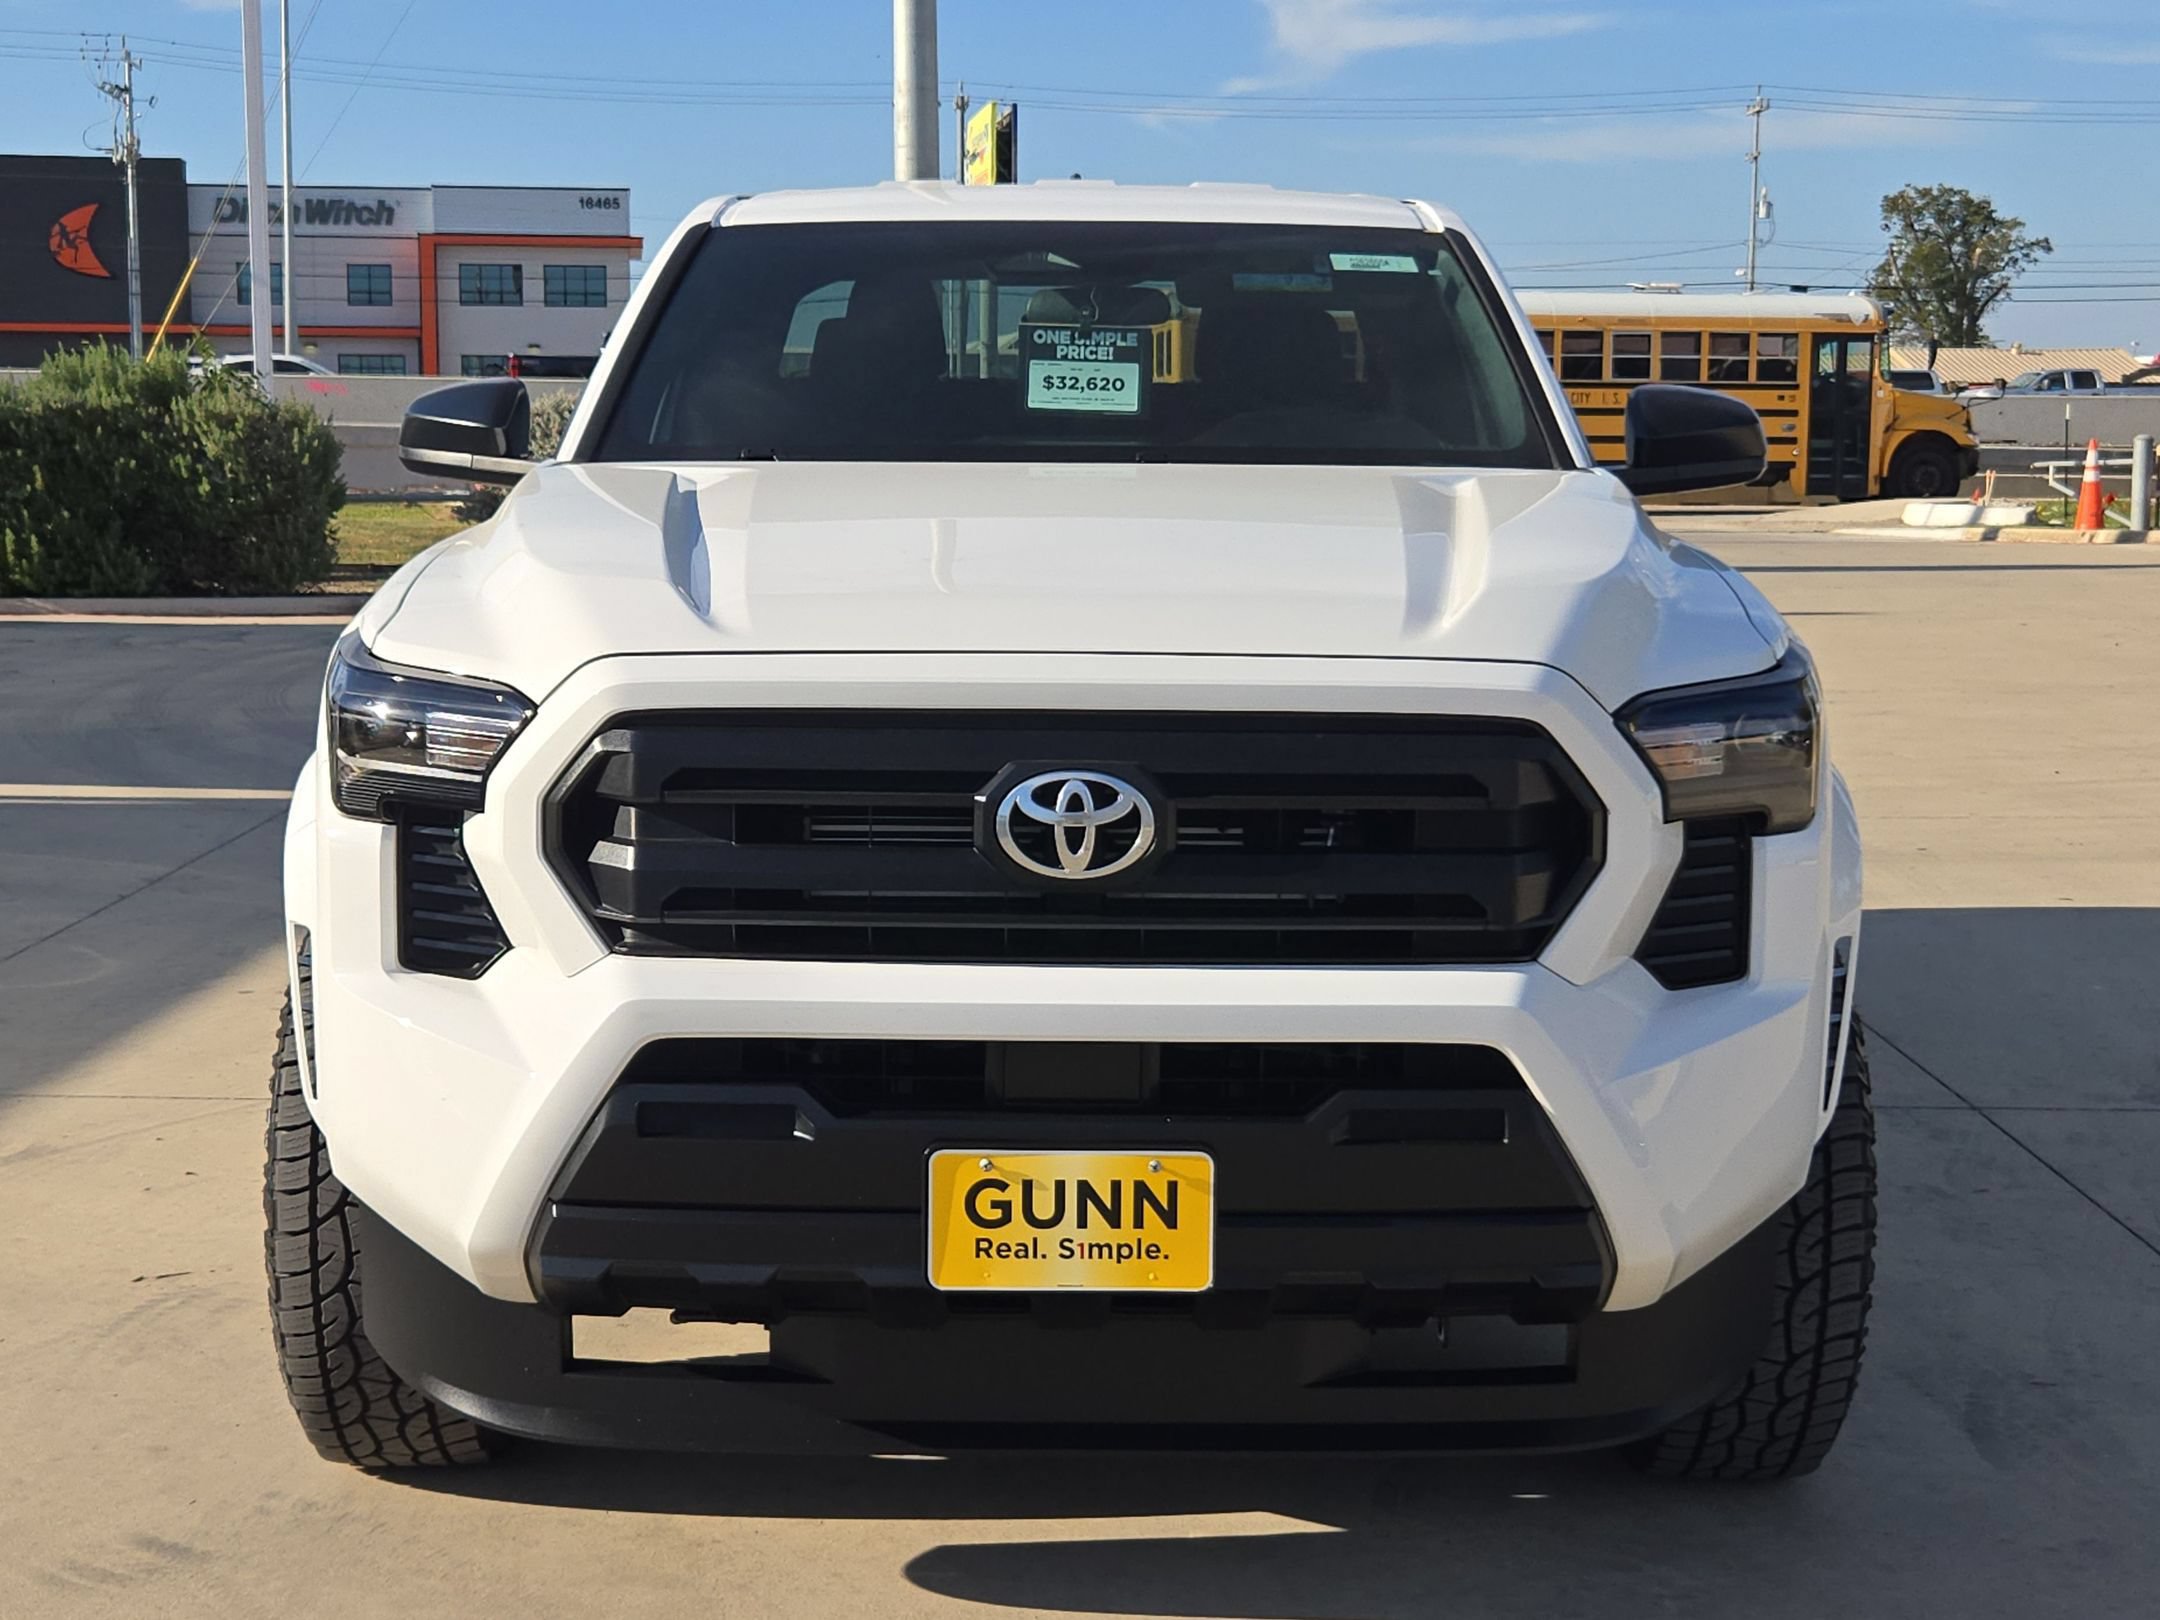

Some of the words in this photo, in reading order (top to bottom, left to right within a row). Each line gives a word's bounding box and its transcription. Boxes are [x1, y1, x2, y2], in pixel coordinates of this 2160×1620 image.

[304, 198, 396, 226] Witch
[578, 196, 621, 210] 16465
[1033, 329, 1072, 345] ONE
[1056, 345, 1114, 361] PRICE!
[1042, 374, 1126, 394] $32,620
[964, 1178, 1179, 1230] GUNN
[974, 1237, 1048, 1260] Real.
